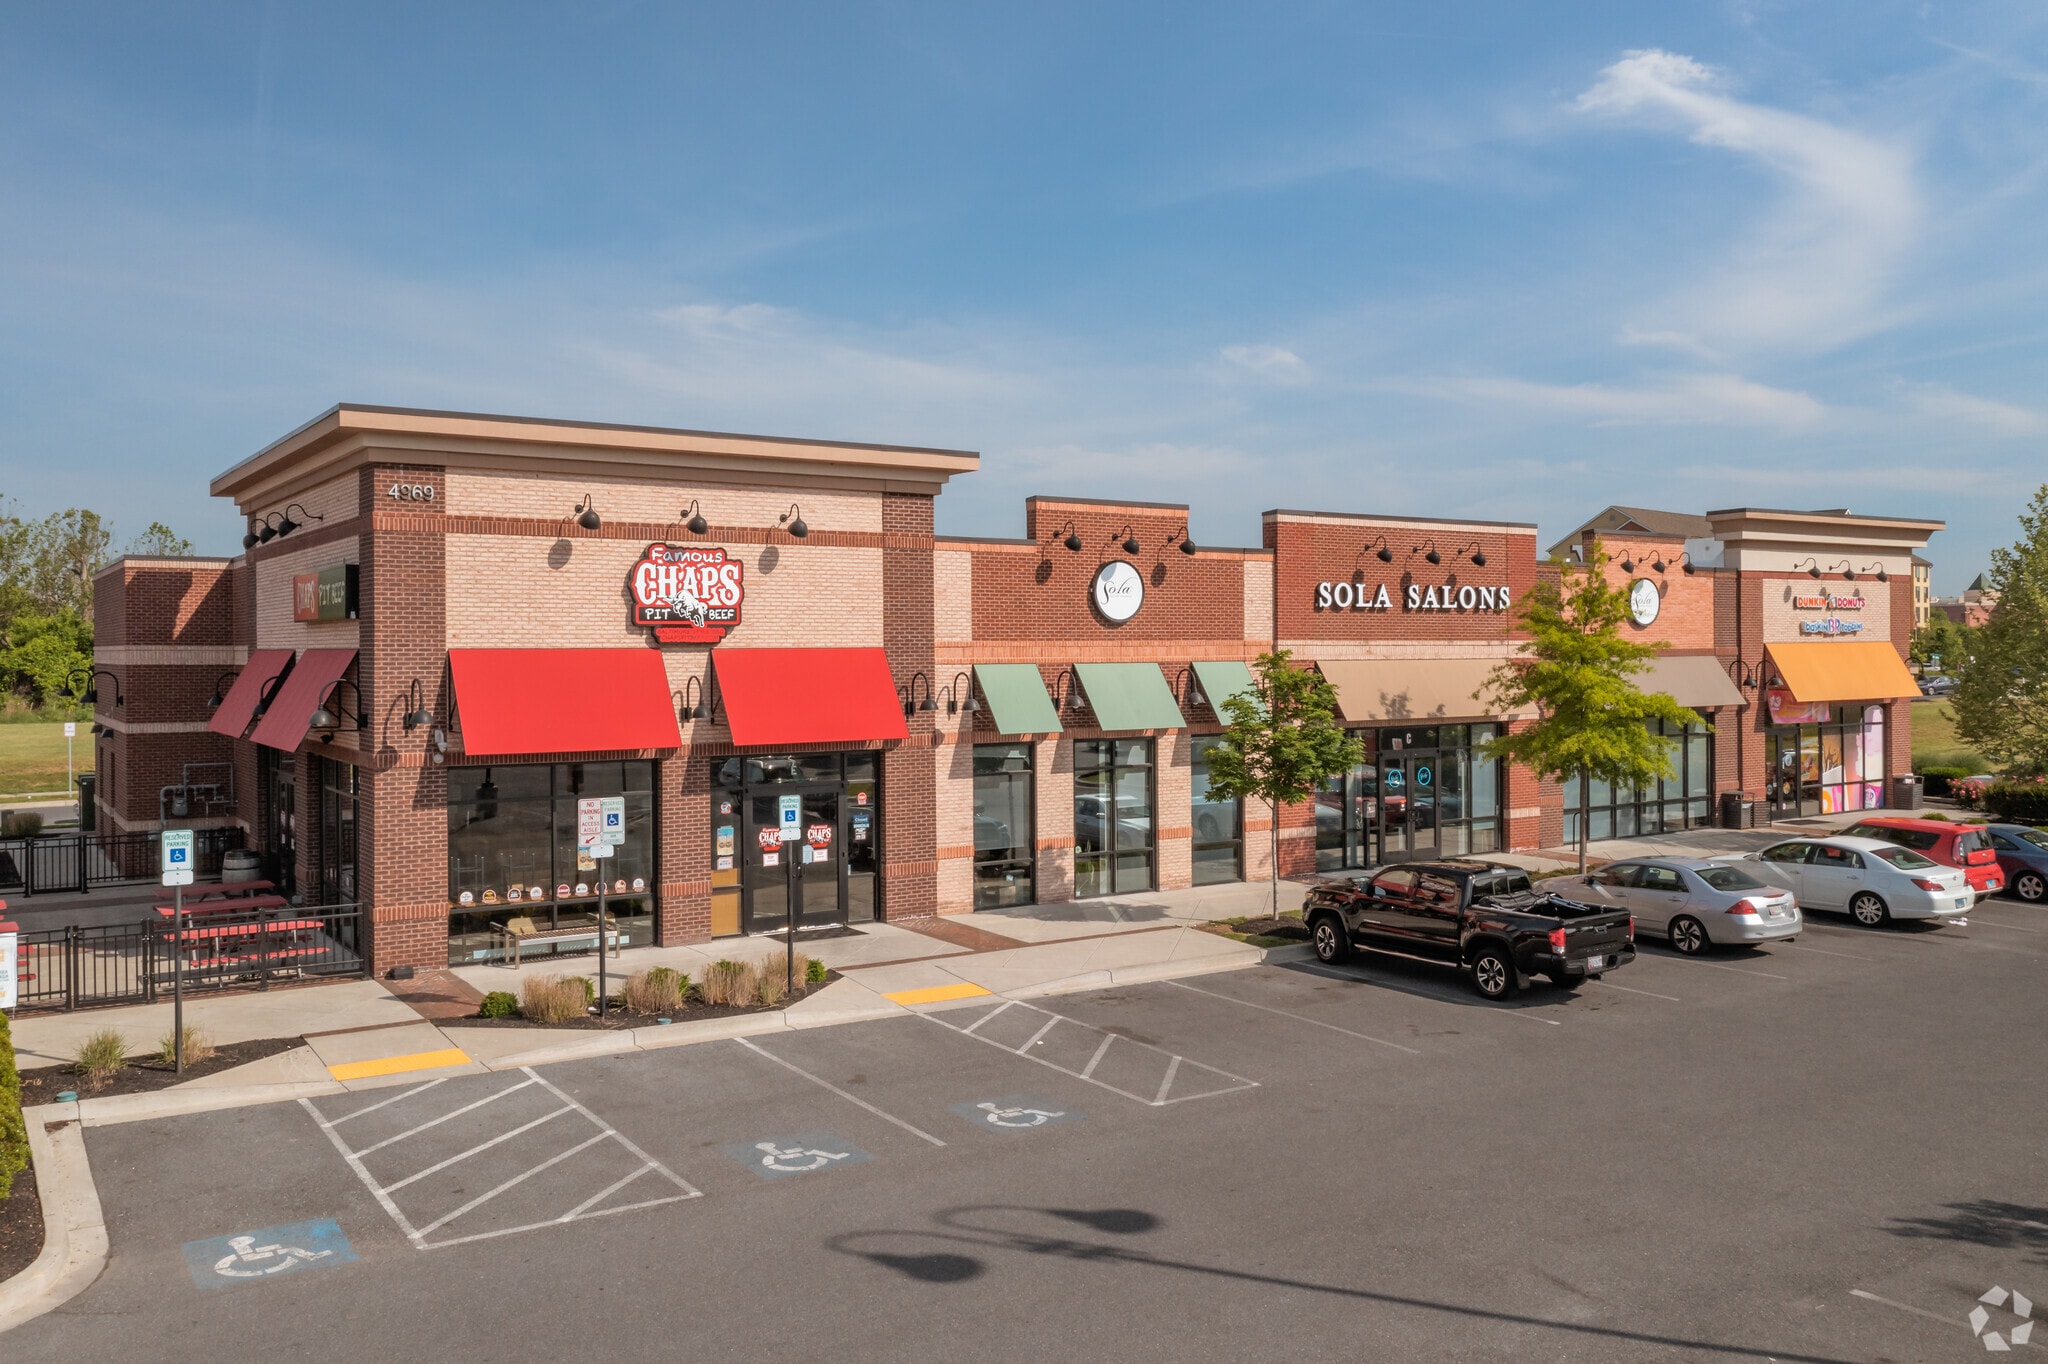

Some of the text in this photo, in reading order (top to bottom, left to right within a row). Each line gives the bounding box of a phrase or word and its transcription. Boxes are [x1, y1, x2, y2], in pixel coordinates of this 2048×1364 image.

[388, 483, 435, 500] 4969
[652, 547, 723, 563] Famous
[635, 562, 740, 606] CHAPS
[1100, 577, 1139, 606] Sola
[319, 583, 330, 606] PIT
[331, 581, 345, 604] BEEF
[1319, 582, 1511, 610] SOLA SALONS
[1837, 597, 1866, 608] DONUTS
[645, 608, 735, 620] PIT BEEF
[1828, 618, 1840, 633] BR
[1406, 732, 1412, 744] C
[807, 828, 831, 839] CHAPS
